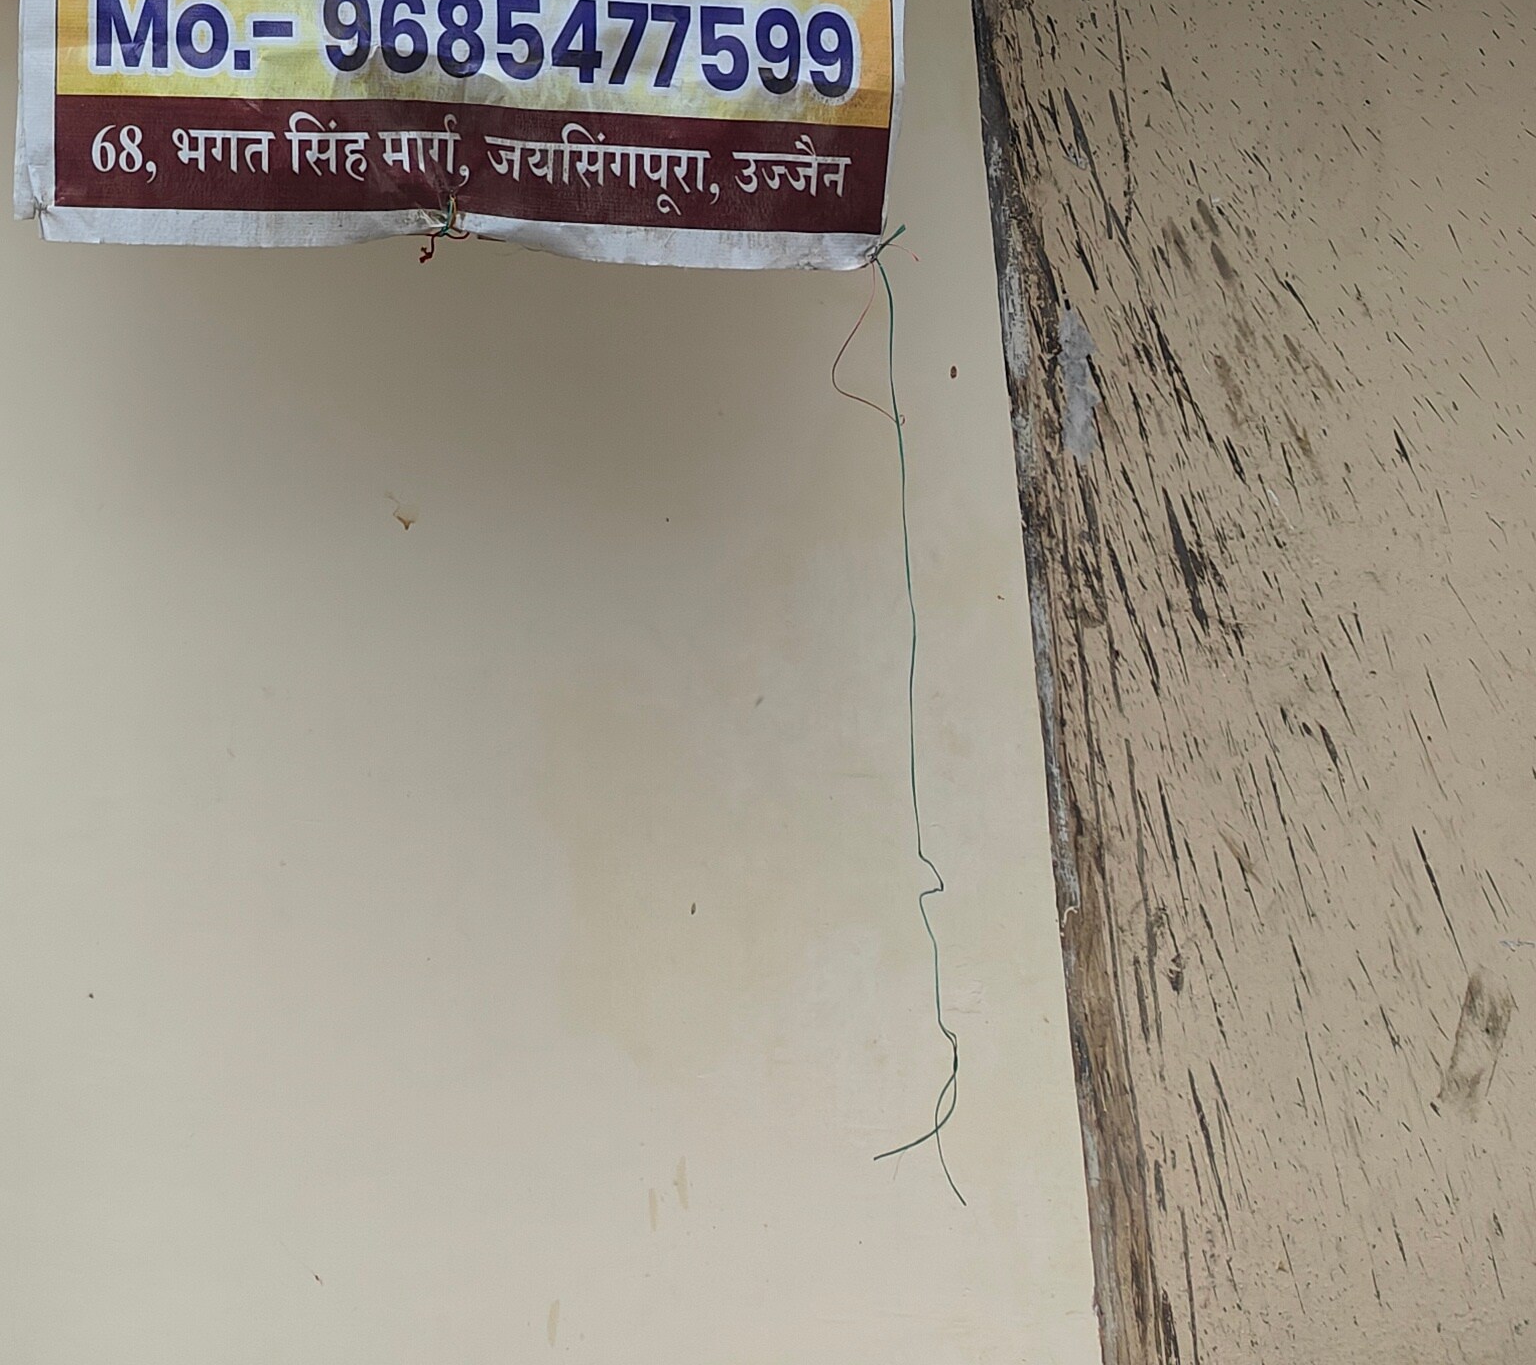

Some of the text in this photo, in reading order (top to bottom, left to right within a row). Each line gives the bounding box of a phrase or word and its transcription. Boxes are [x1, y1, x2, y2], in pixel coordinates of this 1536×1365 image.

[91, 125, 157, 183] 68,
[172, 125, 275, 174] भगत
[284, 111, 370, 181] सिंह
[378, 114, 470, 187] मार्ग,
[732, 135, 852, 197] उज्जैन
